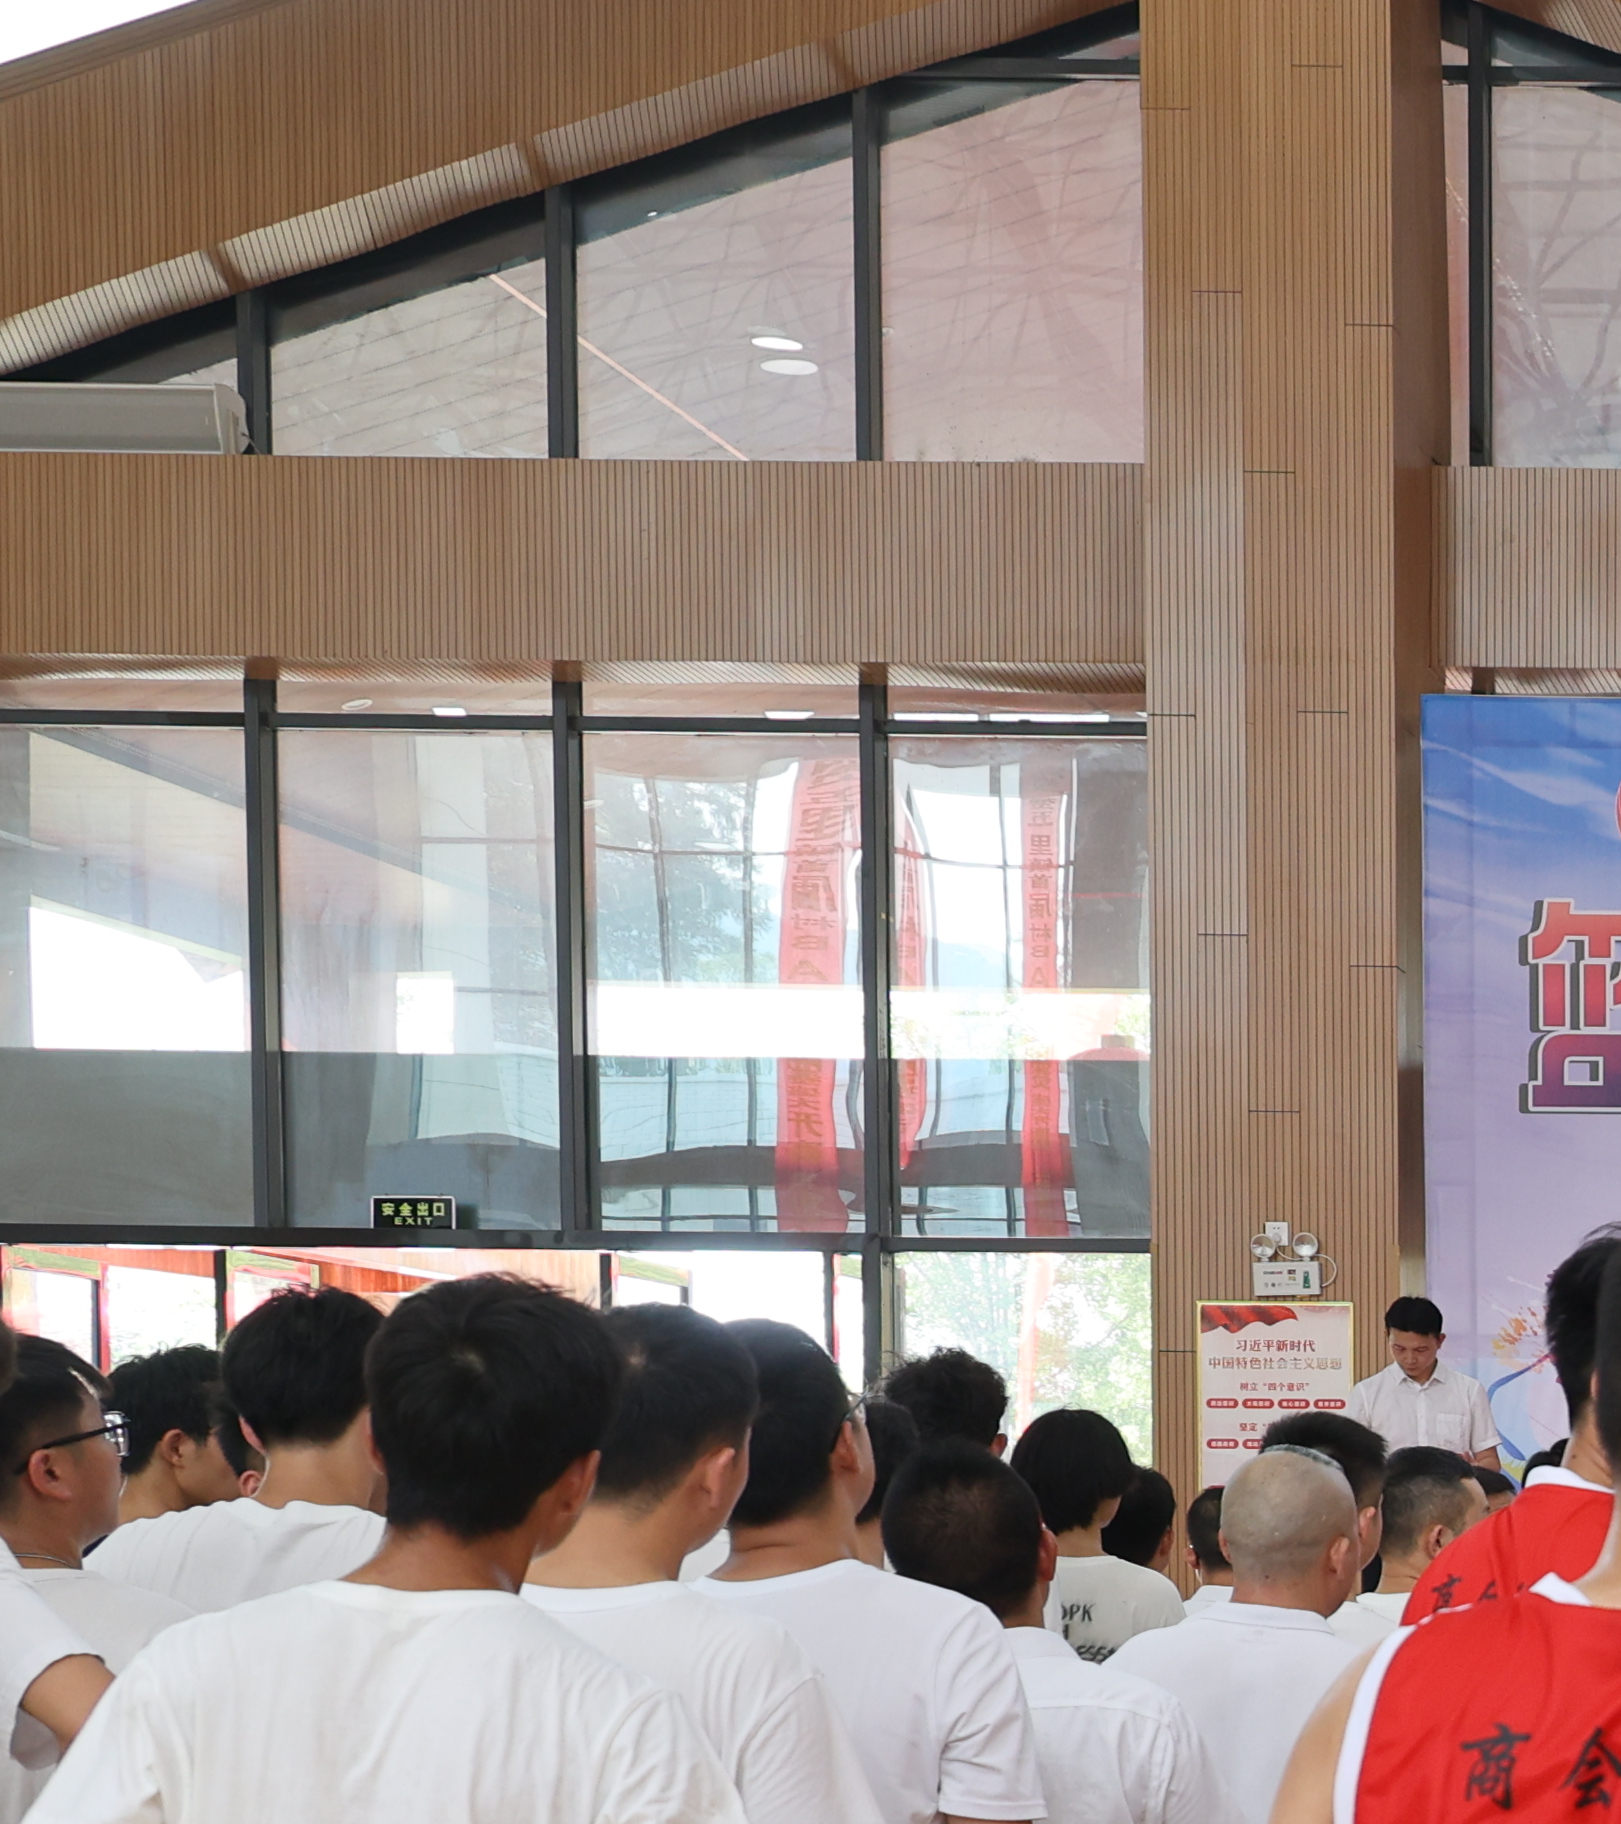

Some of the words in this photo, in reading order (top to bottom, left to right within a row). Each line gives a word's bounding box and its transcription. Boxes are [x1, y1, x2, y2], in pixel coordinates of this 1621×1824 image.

[381, 1202, 446, 1216] 安全出口
[394, 1217, 434, 1226] EXIT
[1235, 1339, 1316, 1353] 习近平新时代
[1208, 1356, 1342, 1371] 中国特色社会主义思想
